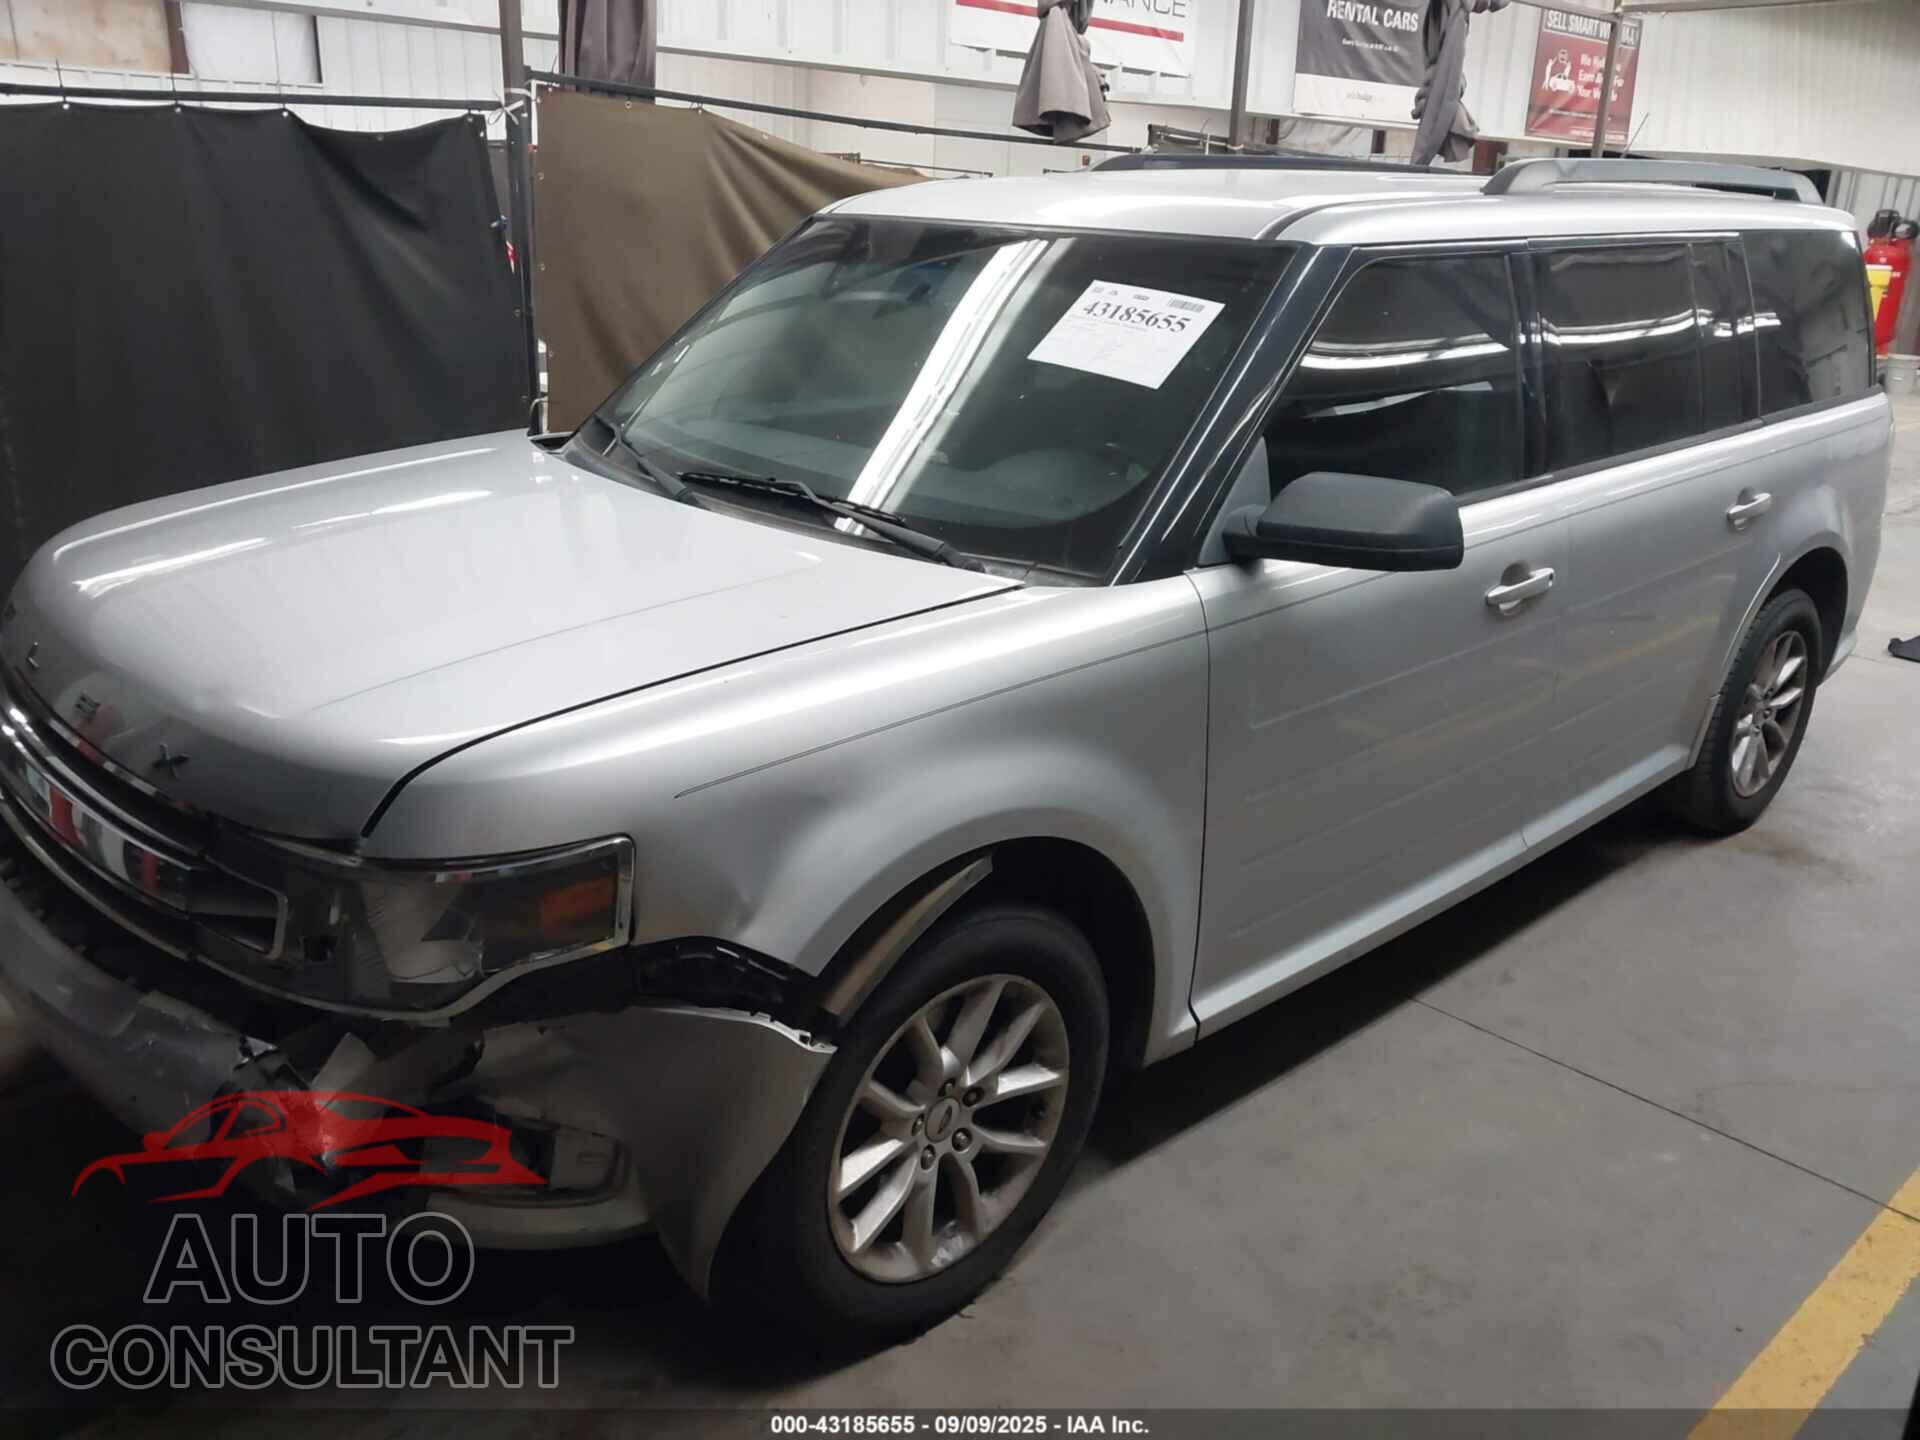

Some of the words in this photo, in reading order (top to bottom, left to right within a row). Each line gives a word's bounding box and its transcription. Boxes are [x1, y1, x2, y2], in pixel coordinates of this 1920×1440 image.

[1327, 0, 1379, 26] RENTAL
[1383, 8, 1419, 32] CARS
[1547, 10, 1567, 31] SELL
[1568, 15, 1600, 38] SMART
[1083, 300, 1191, 333] 43185655
